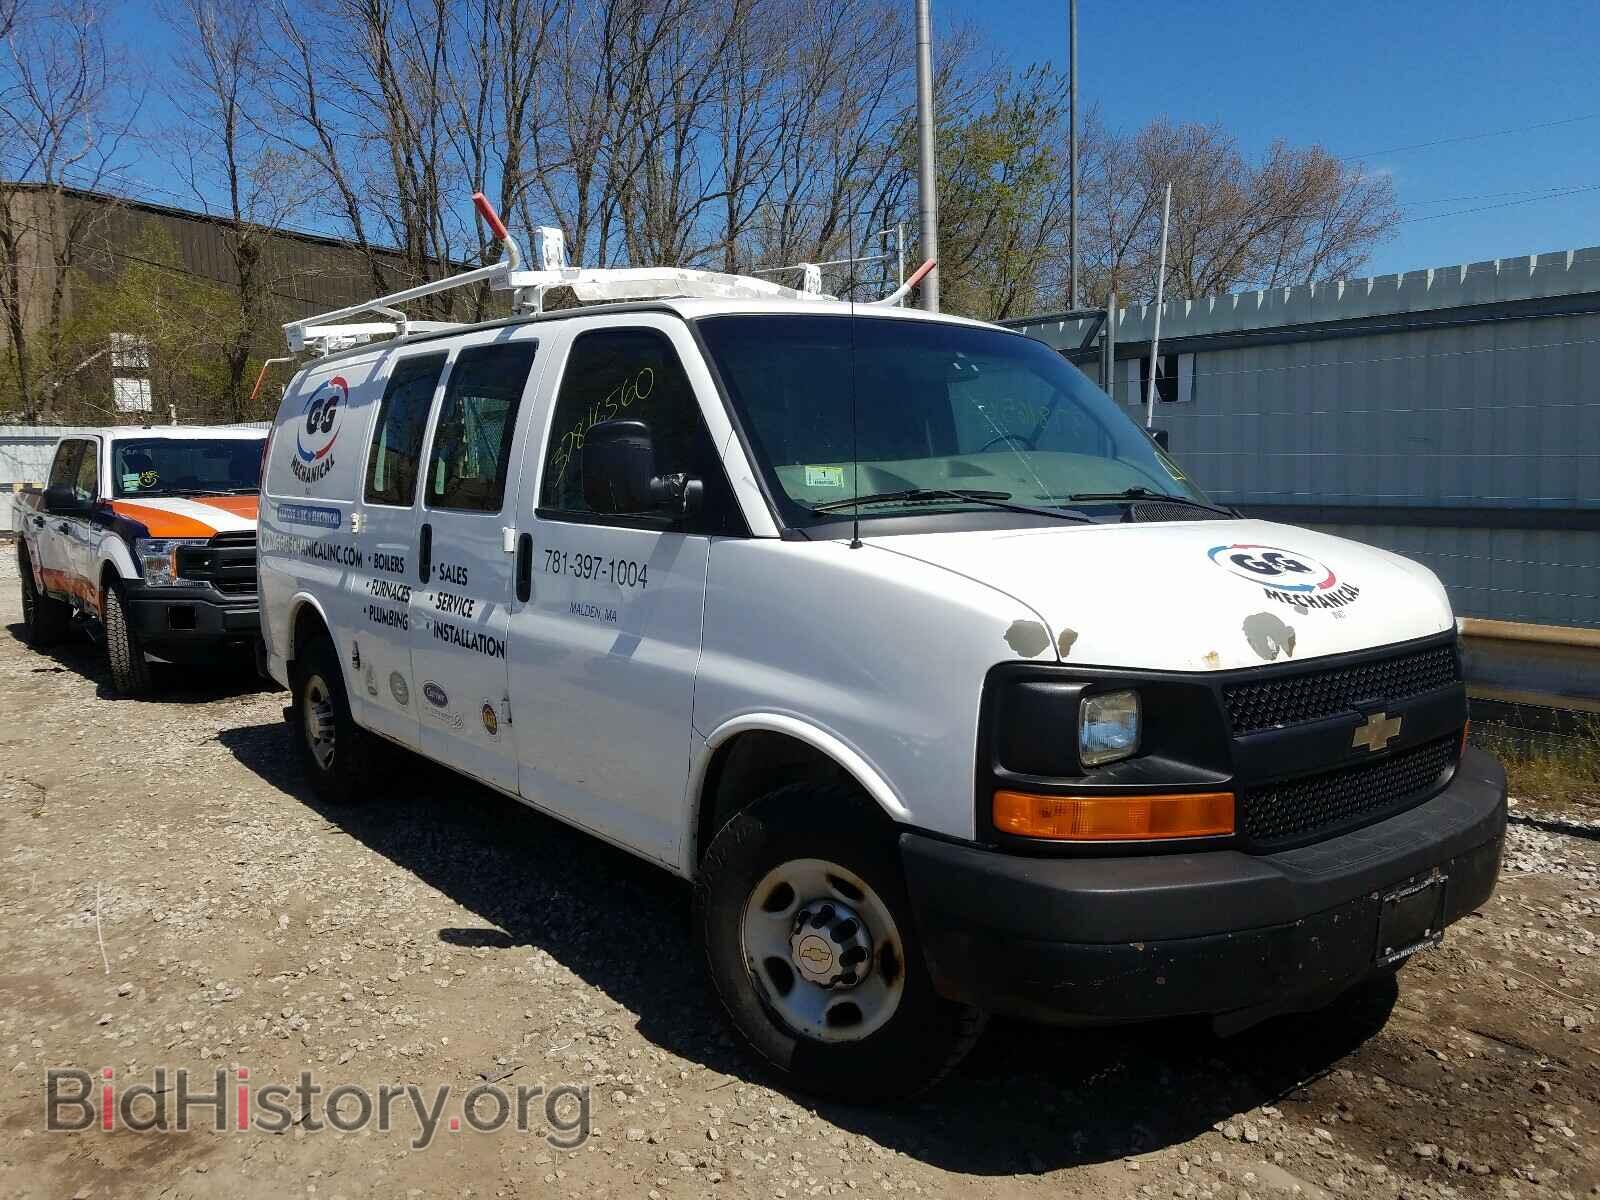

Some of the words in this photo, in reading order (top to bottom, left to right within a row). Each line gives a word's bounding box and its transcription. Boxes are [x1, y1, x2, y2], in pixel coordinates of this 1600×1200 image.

[291, 453, 335, 483] MECHANICAL
[374, 553, 405, 573] BOILERS
[440, 563, 468, 586] SALES
[545, 549, 648, 589] 781-397-1004
[371, 579, 412, 603] FURNACES
[1264, 582, 1360, 609] MECHANICAL
[369, 605, 409, 630] PLUMBING
[435, 592, 475, 618] SERVICE
[569, 601, 602, 621] MALDEN,
[604, 608, 617, 622] MA
[433, 620, 505, 659] INSTALLATION
